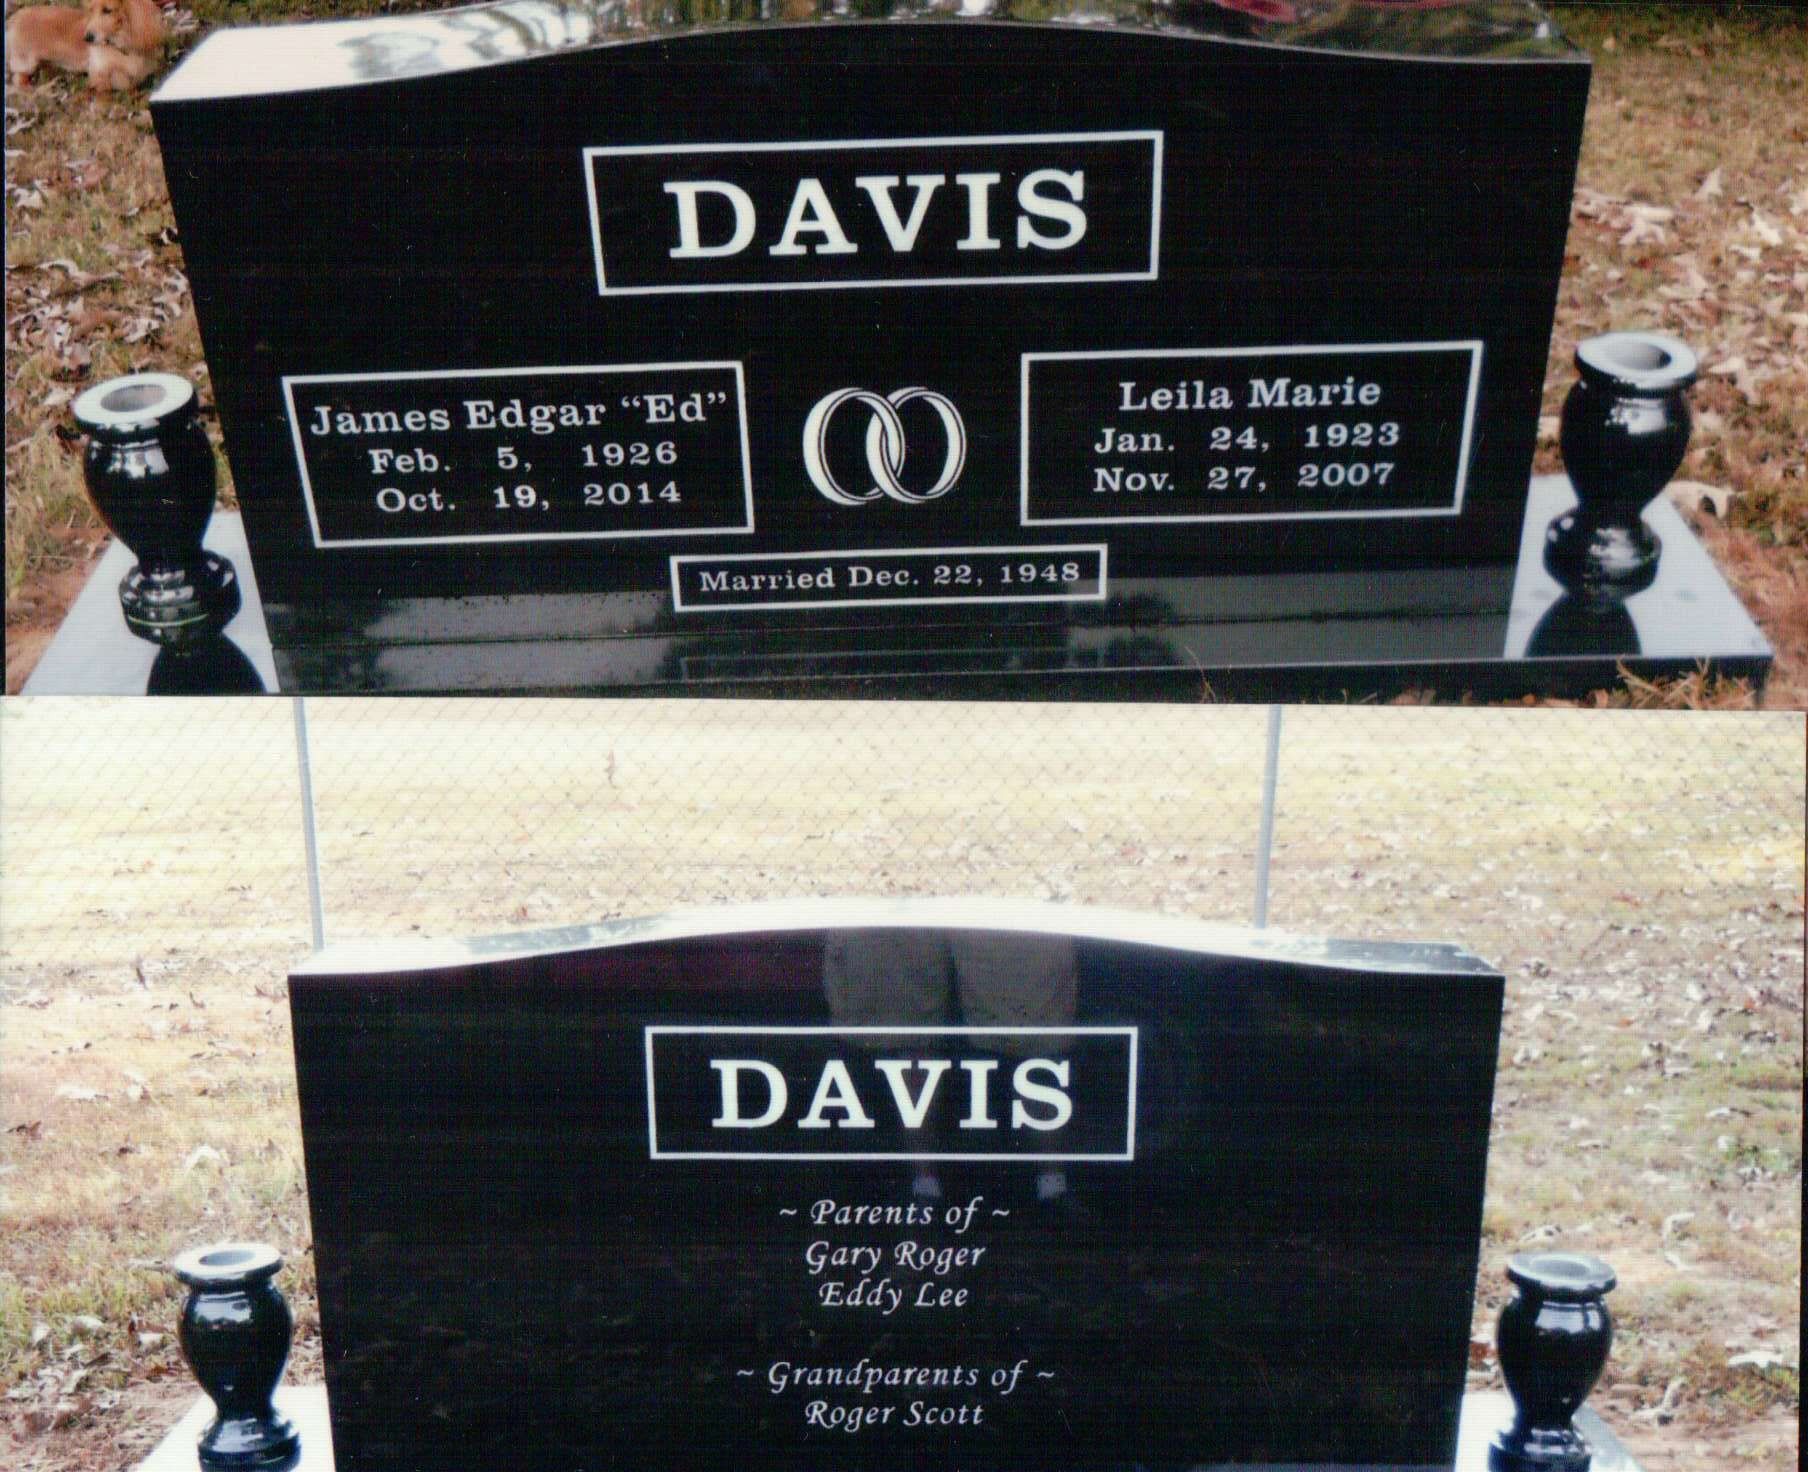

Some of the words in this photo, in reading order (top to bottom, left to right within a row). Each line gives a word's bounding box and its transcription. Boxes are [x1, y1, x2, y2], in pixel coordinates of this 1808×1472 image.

[662, 167, 1088, 259] DAVIS
[1119, 378, 1235, 412] Leila
[1247, 374, 1382, 408] Marie
[309, 404, 451, 436] James
[463, 397, 607, 435] Edgar
[620, 391, 727, 424] “Ed”
[1093, 427, 1176, 455] Jan.
[1209, 424, 1271, 452] 24,
[1304, 421, 1401, 449] 1923
[368, 446, 452, 475] Feb.
[496, 445, 533, 472] 5,
[581, 440, 679, 468] 1926
[1092, 465, 1176, 493] Nov.
[1207, 464, 1267, 492] 27,
[1297, 461, 1396, 488] 2007
[375, 484, 457, 514] Oct.
[493, 483, 550, 511] 19,
[582, 480, 682, 507] 2014
[699, 565, 836, 594] Married
[848, 564, 921, 590] Dec.
[933, 563, 984, 588] 22,
[1000, 560, 1081, 586] 1948
[709, 1057, 1074, 1132] DAVIS
[810, 1198, 934, 1226] Parents
[944, 1195, 985, 1235] of
[805, 1240, 881, 1276] Gary
[893, 1240, 986, 1276] Roger
[818, 1277, 902, 1316] Eddy
[914, 1281, 969, 1308] Lee
[767, 1358, 979, 1395] Grandparents
[990, 1359, 1029, 1396] of
[804, 1400, 895, 1433] Roger
[903, 1400, 984, 1427] Scott
